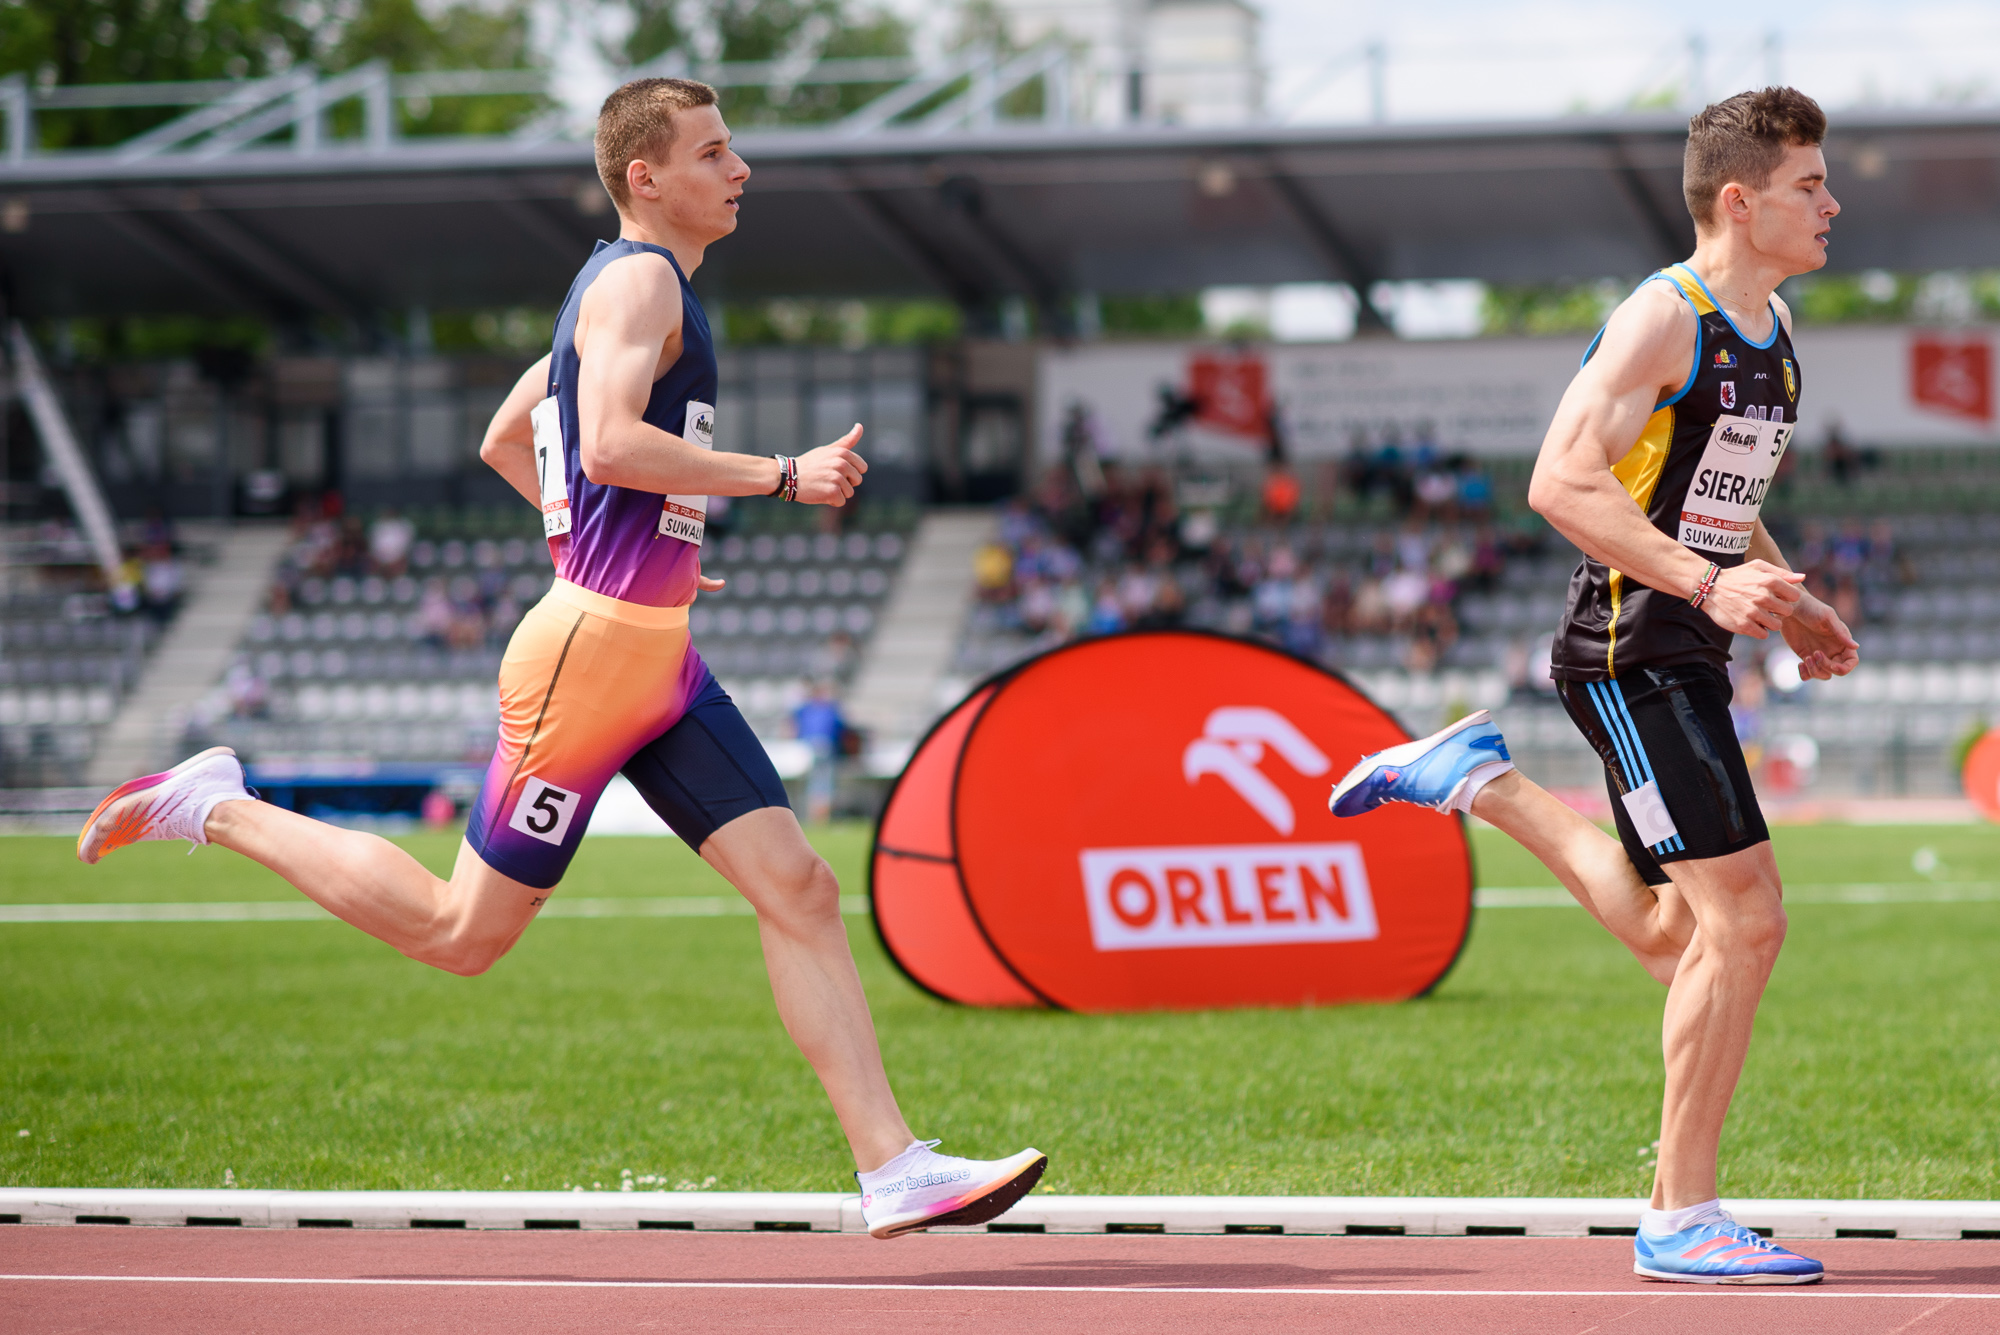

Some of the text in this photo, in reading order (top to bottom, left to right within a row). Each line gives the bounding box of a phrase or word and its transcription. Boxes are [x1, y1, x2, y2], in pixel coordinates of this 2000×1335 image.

[1686, 513, 1698, 523] 98.
[1700, 516, 1722, 528] PZLA
[526, 786, 567, 834] 5
[1108, 863, 1351, 928] ORLEN
[874, 1168, 971, 1200] new balance
